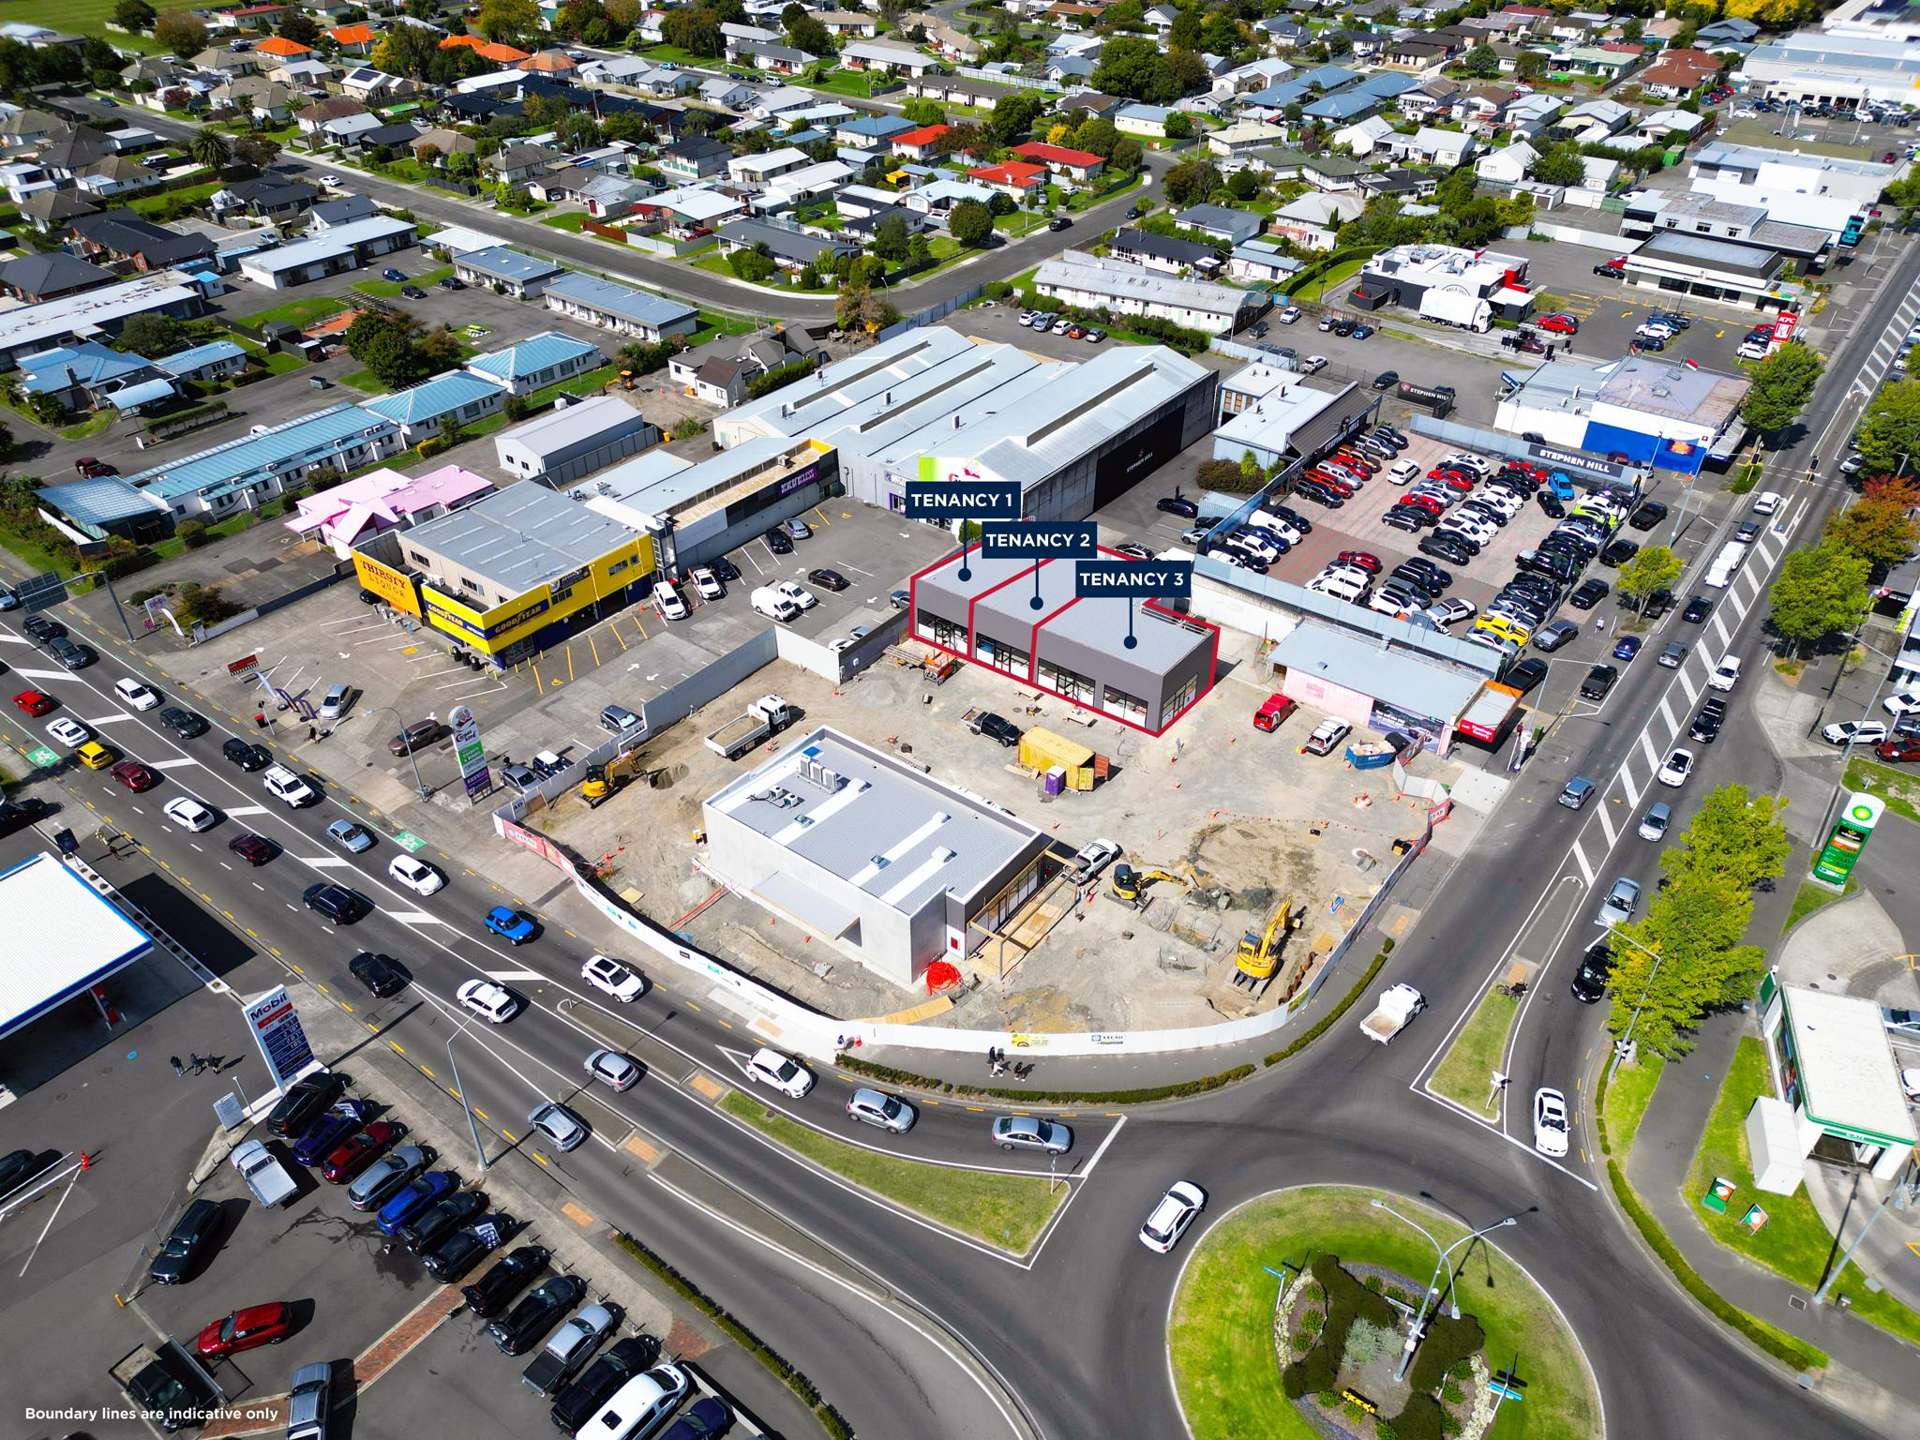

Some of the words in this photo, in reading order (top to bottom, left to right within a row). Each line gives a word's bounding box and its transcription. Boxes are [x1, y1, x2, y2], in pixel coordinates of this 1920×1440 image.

[1410, 387, 1436, 398] STEPHEN
[1539, 449, 1585, 467] STEPHEN
[1586, 460, 1610, 473] HILL
[362, 561, 406, 588] THIRSTY
[495, 606, 542, 633] GOODYEAR
[250, 993, 287, 1021] Mobil
